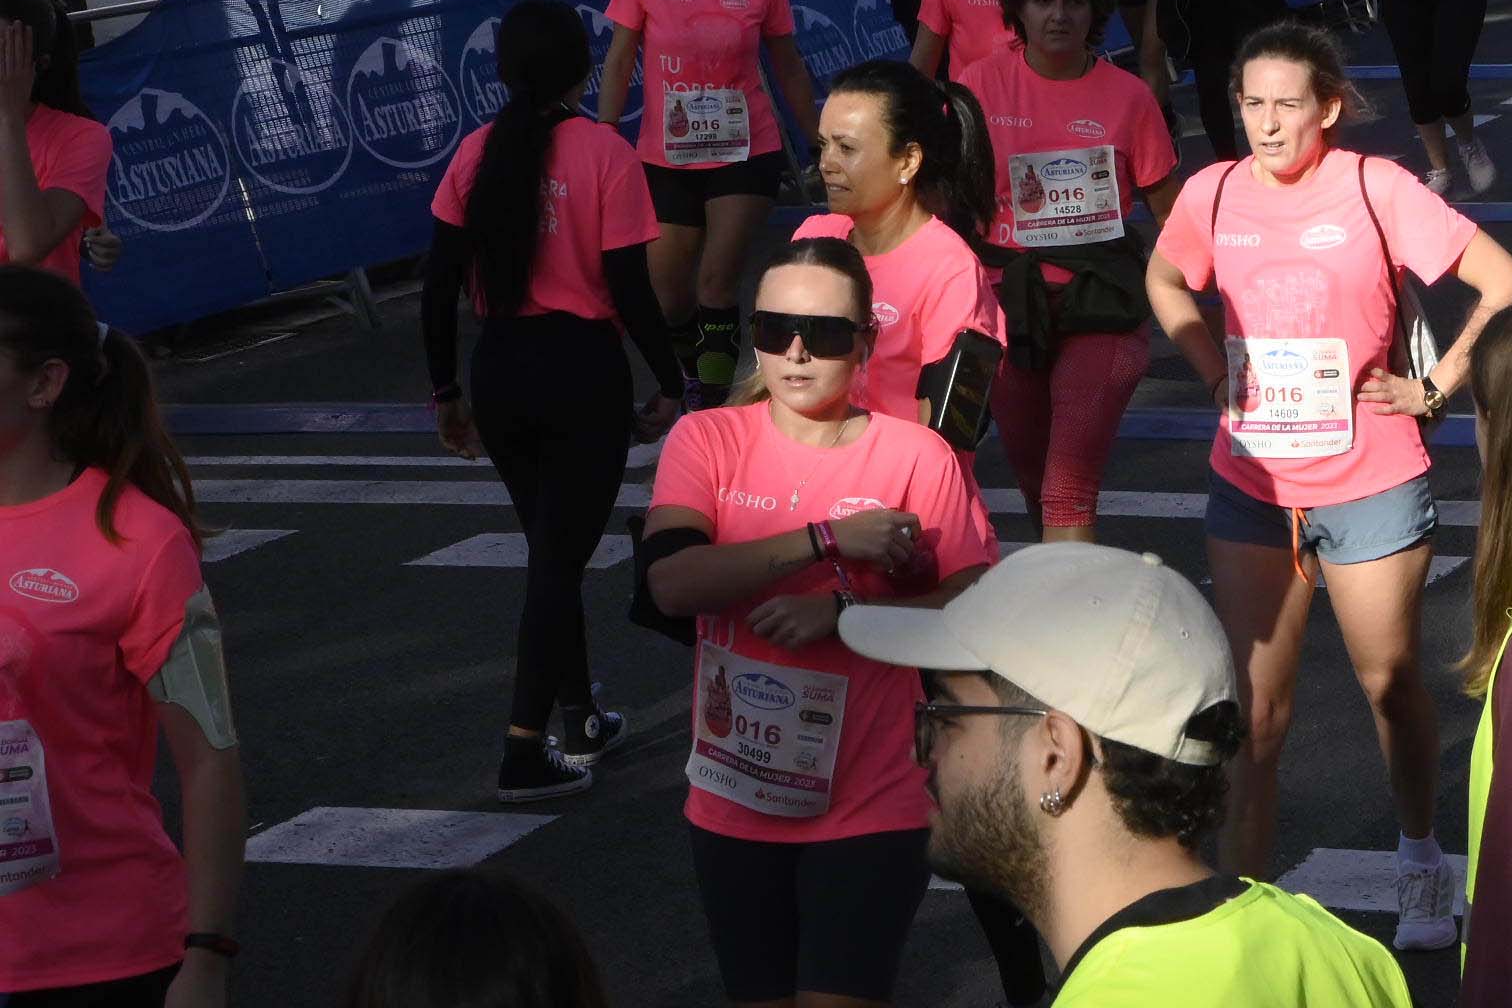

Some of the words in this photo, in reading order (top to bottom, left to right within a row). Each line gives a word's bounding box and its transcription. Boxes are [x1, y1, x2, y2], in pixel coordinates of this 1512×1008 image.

[660, 54, 684, 74] TU
[691, 119, 720, 131] 016
[990, 115, 1033, 128] OYSHO
[115, 142, 224, 202] ASTURIANA
[1048, 187, 1085, 203] 016
[1054, 205, 1082, 215] 14528
[1025, 232, 1059, 242] OYSHO
[1216, 232, 1262, 248] OYSHO
[1265, 386, 1303, 403] 016
[1268, 408, 1300, 419] 14609
[1239, 439, 1272, 449] OYSHO
[717, 486, 778, 511] OYSHO
[15, 575, 73, 601] ASTURIANA
[735, 680, 790, 706] ASTURIANA
[734, 714, 782, 746] 016
[0, 743, 29, 756] UMA
[737, 741, 772, 765] 30499
[699, 765, 738, 790] OYSHO
